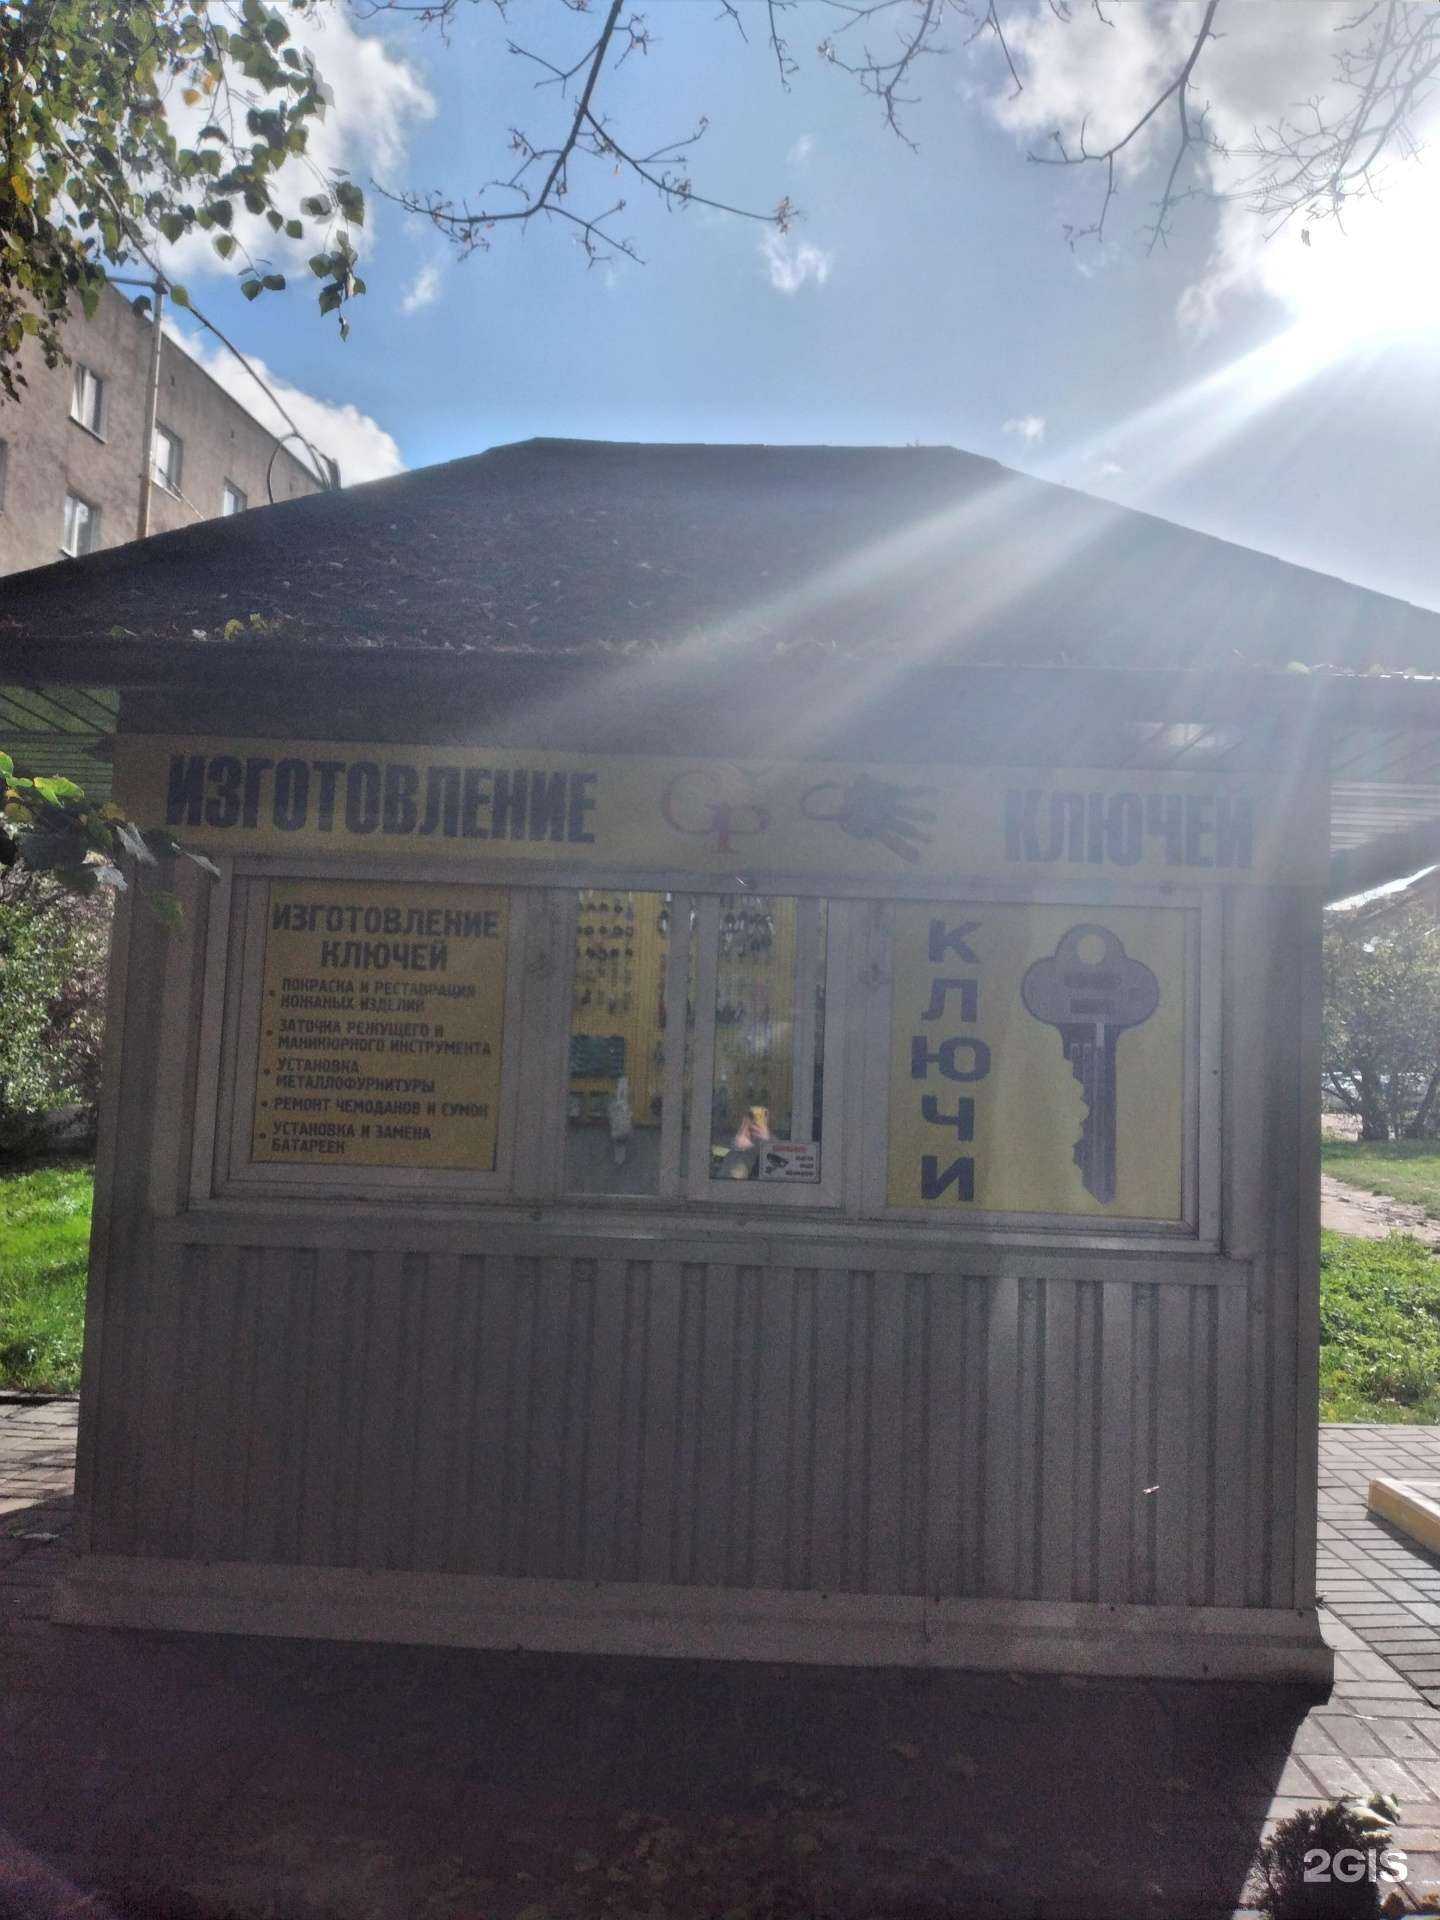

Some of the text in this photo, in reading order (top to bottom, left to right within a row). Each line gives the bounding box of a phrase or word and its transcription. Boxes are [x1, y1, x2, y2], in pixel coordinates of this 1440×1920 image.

[166, 754, 598, 843] ИЗГОТОВЛЕНИЕ
[1003, 785, 1253, 869] КЛЮЧЕЙ
[272, 903, 498, 938] ИЗГОТОВЛЕНИЕ
[320, 940, 448, 971] КЛЮЧЕЙ
[281, 978, 476, 998] ПОКРАСКА И РЕСТАВРАЦИЯ
[280, 994, 354, 1010] КОЖАНЫХ
[279, 1018, 444, 1038] ЗАТОЧКА РЕЖУЩЕГО И
[277, 1036, 492, 1056] МАНИКЮРНОГО ИНСТРУМЕНТА
[276, 1057, 360, 1074] УСТАНОВКА
[275, 1075, 436, 1093] МЕТАЛЛОФУРНИТУРЫ
[273, 1097, 489, 1118] РЕМОНТ ЧЕМОДАНОВ И СУМОК
[272, 1121, 432, 1141] УСТАНОВКА И ЗАМЕНА
